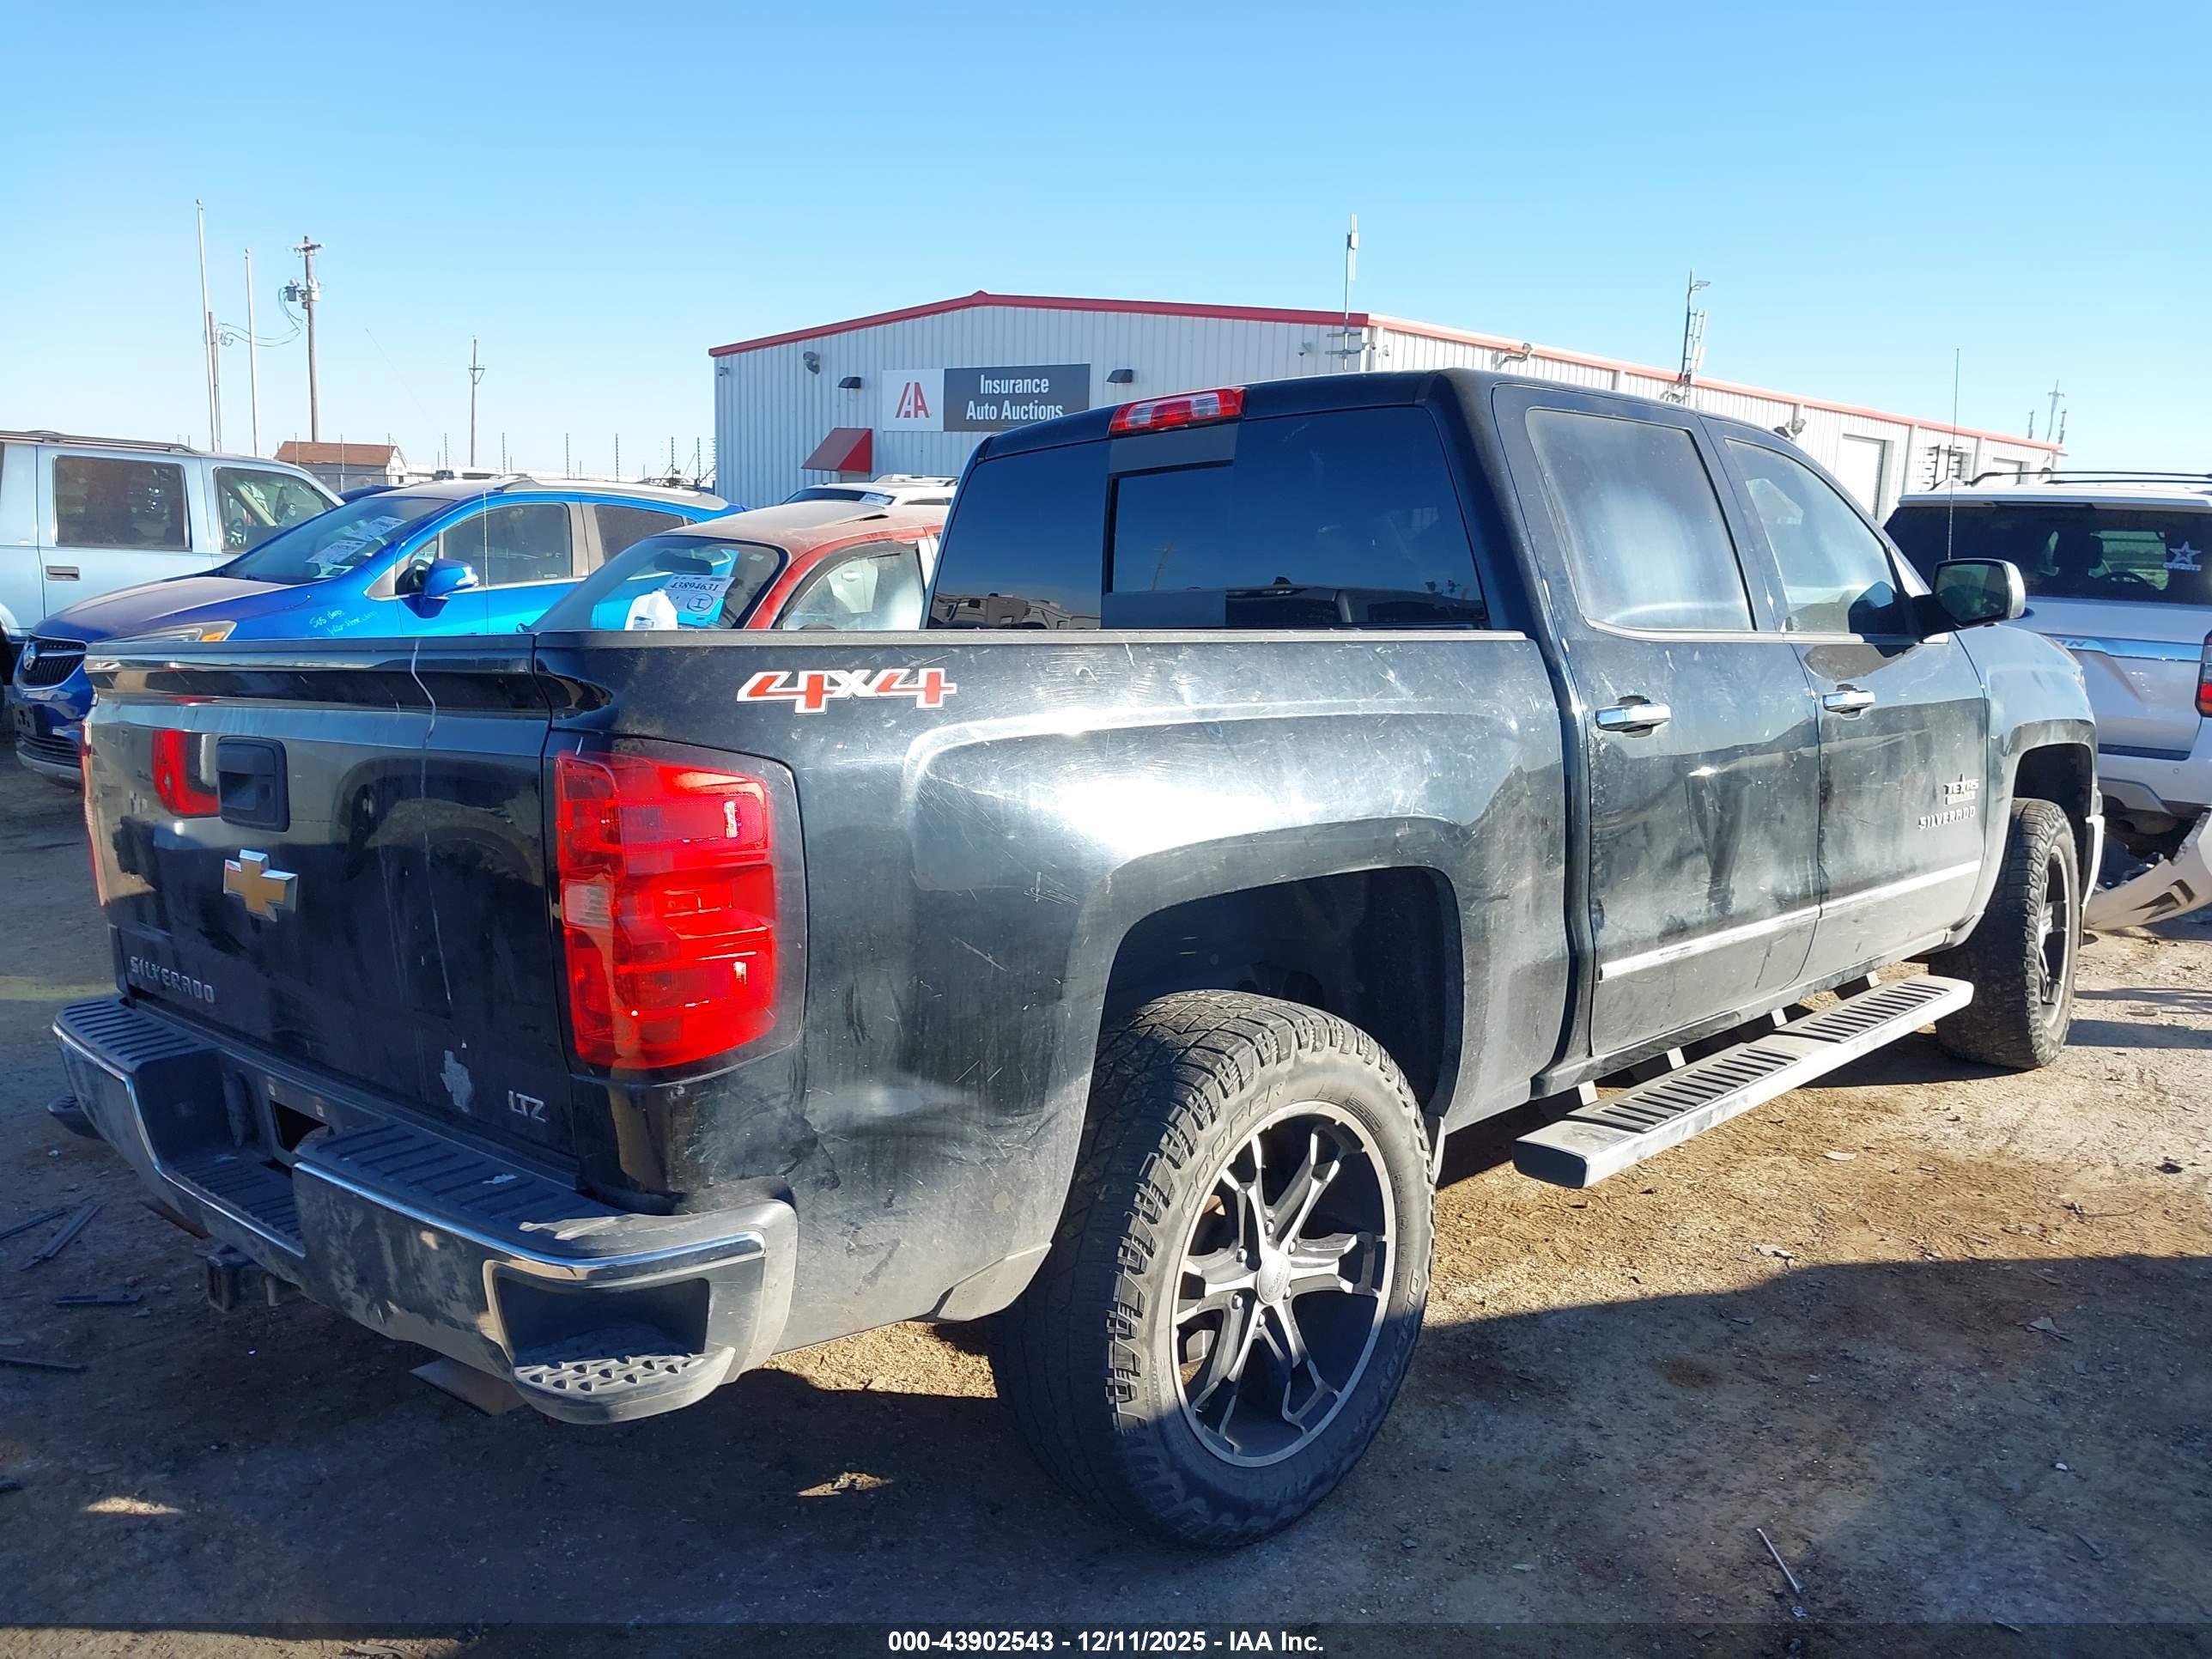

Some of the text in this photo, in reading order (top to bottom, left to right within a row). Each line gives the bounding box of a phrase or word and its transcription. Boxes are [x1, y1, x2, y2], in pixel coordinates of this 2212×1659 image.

[980, 374, 1049, 395] Insurance
[965, 398, 1063, 421] Auto Auctions
[670, 581, 720, 592] 43894631
[1917, 805, 1976, 831] SILVERADO
[130, 955, 215, 1003] SILVERADO
[507, 1090, 547, 1123] LTZ
[1181, 1083, 1285, 1219] COOPER
